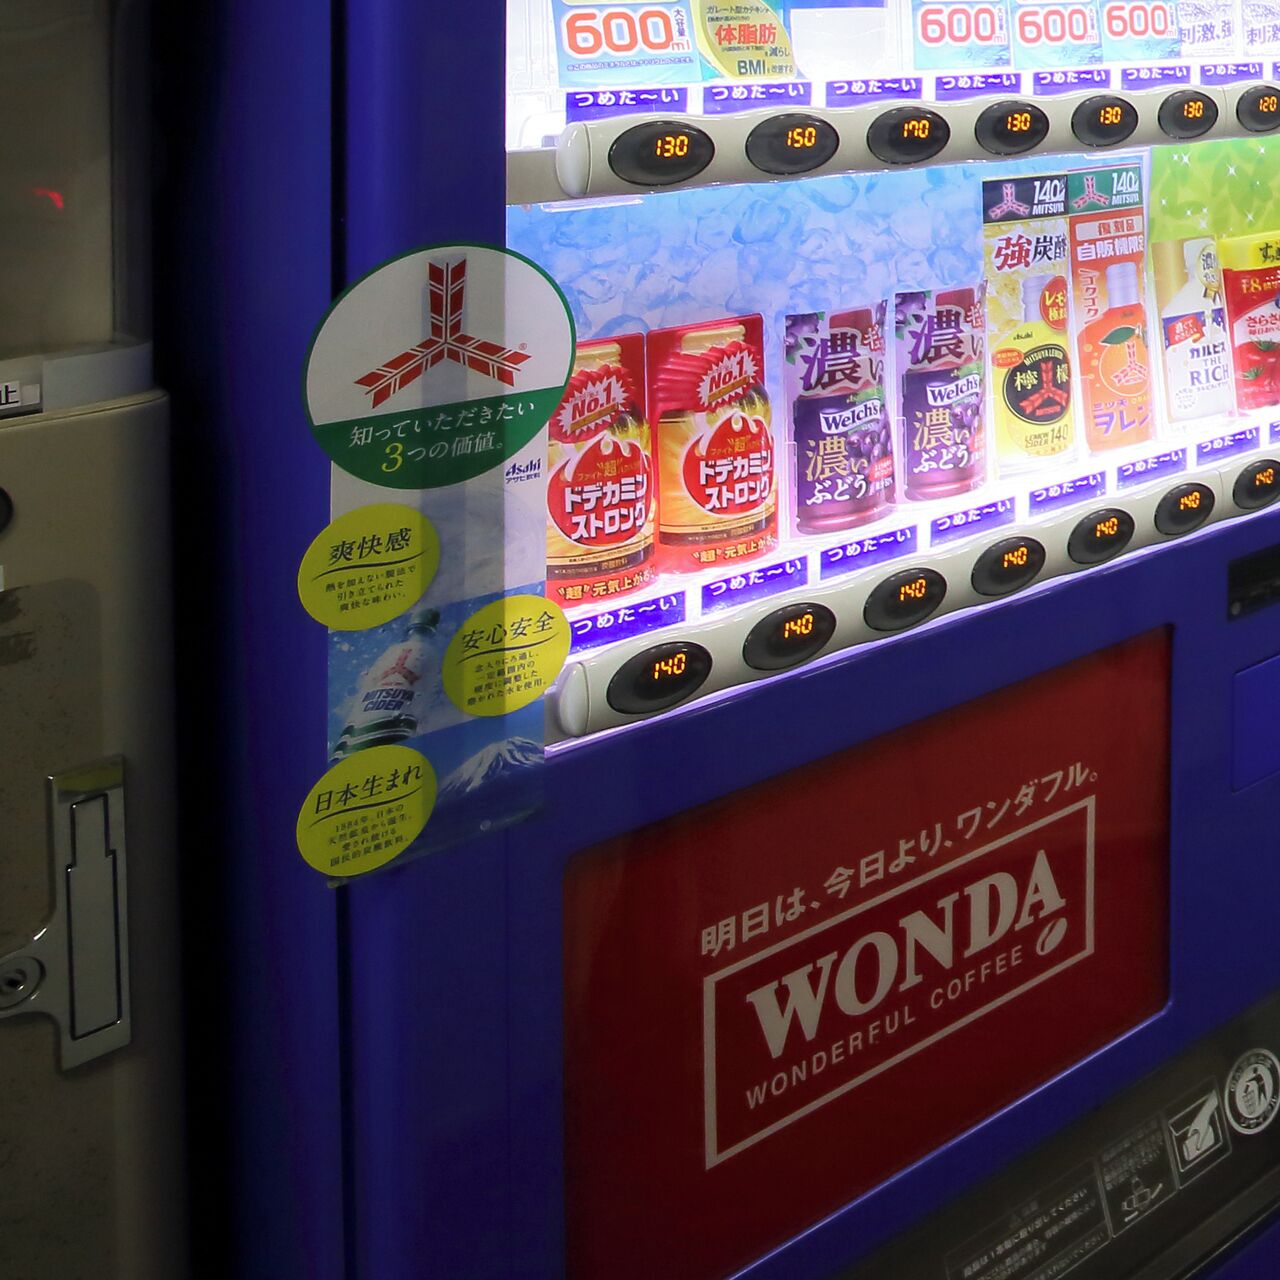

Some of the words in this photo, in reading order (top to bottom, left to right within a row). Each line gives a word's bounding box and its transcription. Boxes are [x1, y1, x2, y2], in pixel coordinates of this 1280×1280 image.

[714, 23, 778, 47] 体脂肪
[1099, 106, 1121, 124] 130
[1182, 101, 1203, 118] 130
[1258, 96, 1277, 112] 120
[1006, 112, 1031, 131] 130
[655, 135, 688, 157] 130
[786, 127, 816, 148] 150
[1032, 200, 1065, 216] MITSUYA
[1203, 355, 1223, 366] THE
[1189, 364, 1230, 387] RICH
[928, 374, 980, 404] Welch's
[348, 400, 536, 449] 知っていただきたい
[822, 400, 881, 432] Welch's
[505, 457, 543, 478] Asahi
[699, 449, 772, 486] ドデカミン
[913, 446, 970, 474] ぶどう
[1254, 468, 1274, 485] 140
[564, 472, 648, 513] ドデカミン
[704, 474, 770, 511] ストロング
[805, 474, 868, 505] ぶどう
[1179, 491, 1200, 510] 140
[569, 502, 647, 541] ストロング
[1095, 517, 1118, 537] 140
[328, 526, 413, 564] 爽快感
[1002, 547, 1028, 568] 140
[899, 579, 926, 601] 140
[461, 610, 557, 653] 安心安全
[783, 614, 813, 638] 140
[653, 653, 686, 680] 140
[313, 763, 424, 816] 日本生まれ
[700, 761, 1098, 958] 明日は、今日より、ワンダフル。
[745, 849, 1067, 1060] WONDA
[744, 1004, 917, 1110] WONDERFUL
[929, 944, 1025, 1010] COFFEE
